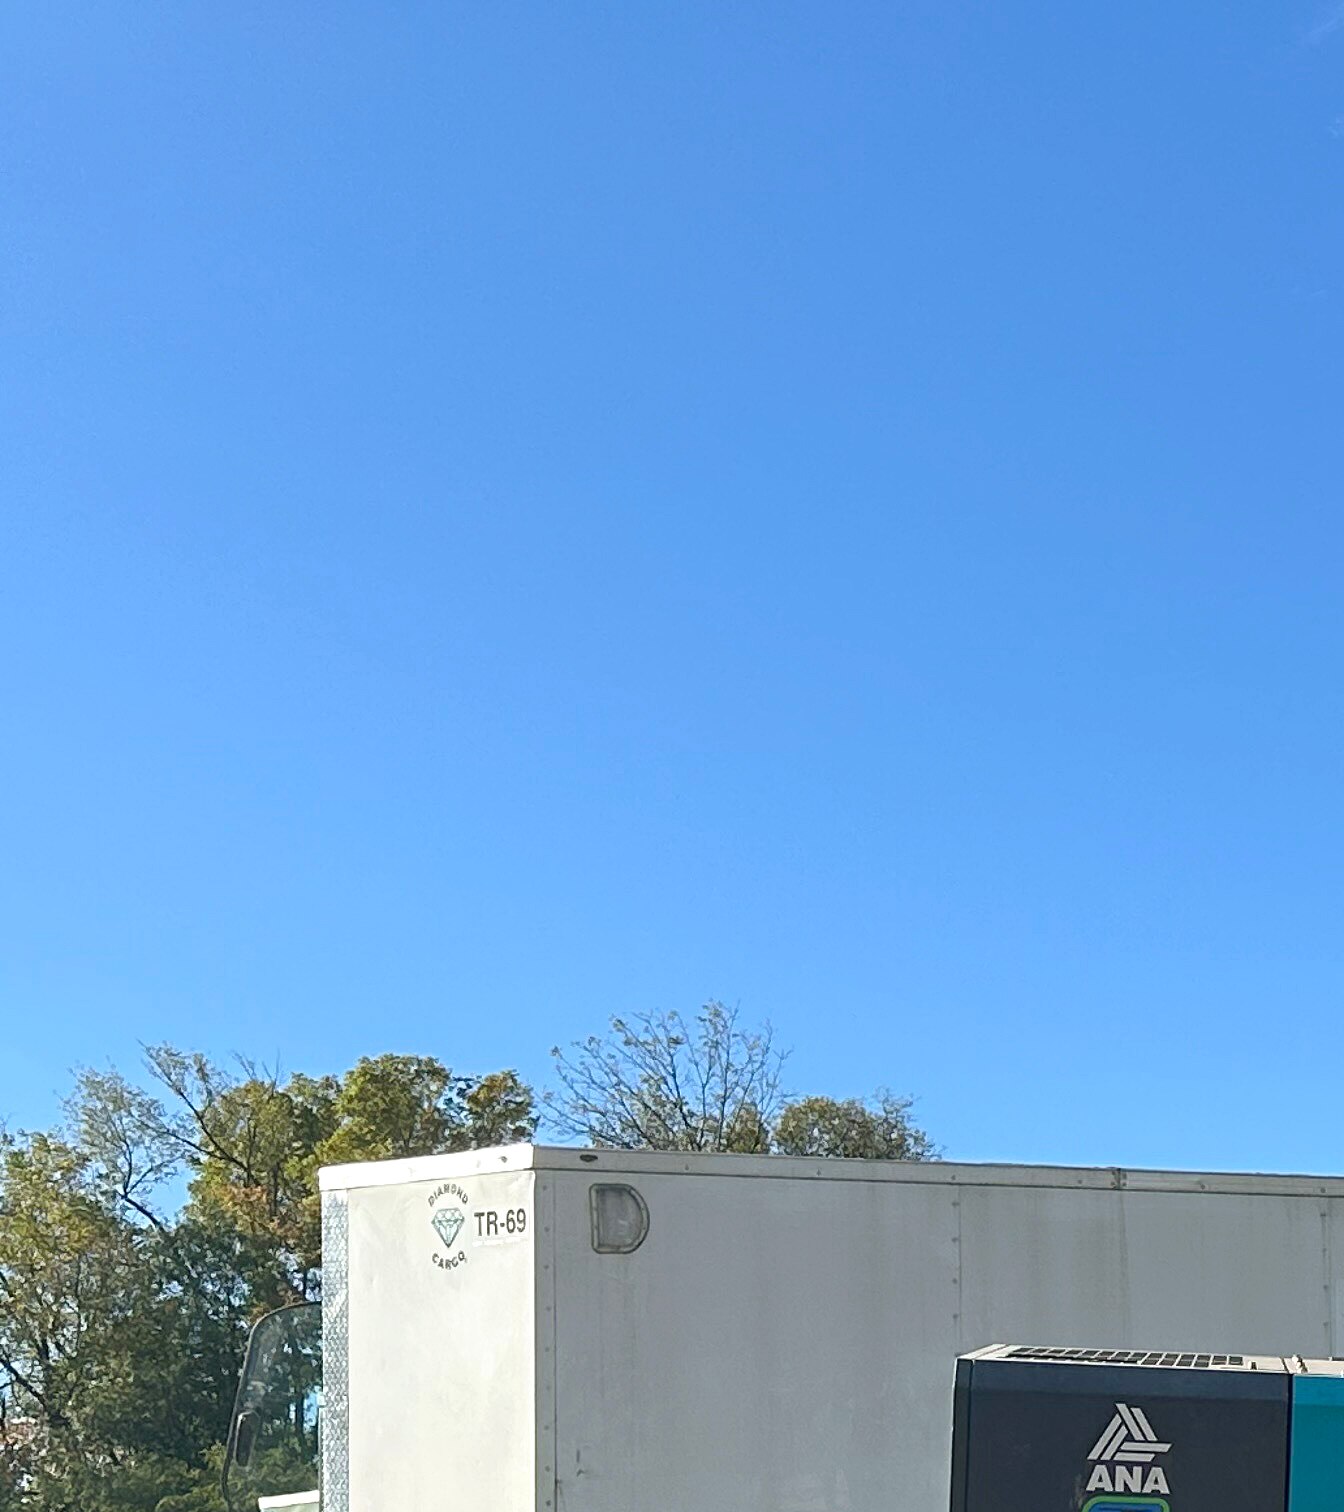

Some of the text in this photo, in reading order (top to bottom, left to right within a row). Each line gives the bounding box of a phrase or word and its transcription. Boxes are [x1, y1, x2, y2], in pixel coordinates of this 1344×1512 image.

[428, 1184, 469, 1207] DIAMOND
[474, 1208, 527, 1237] TR-69
[432, 1251, 466, 1270] CARGO
[1086, 1464, 1171, 1495] ANA
